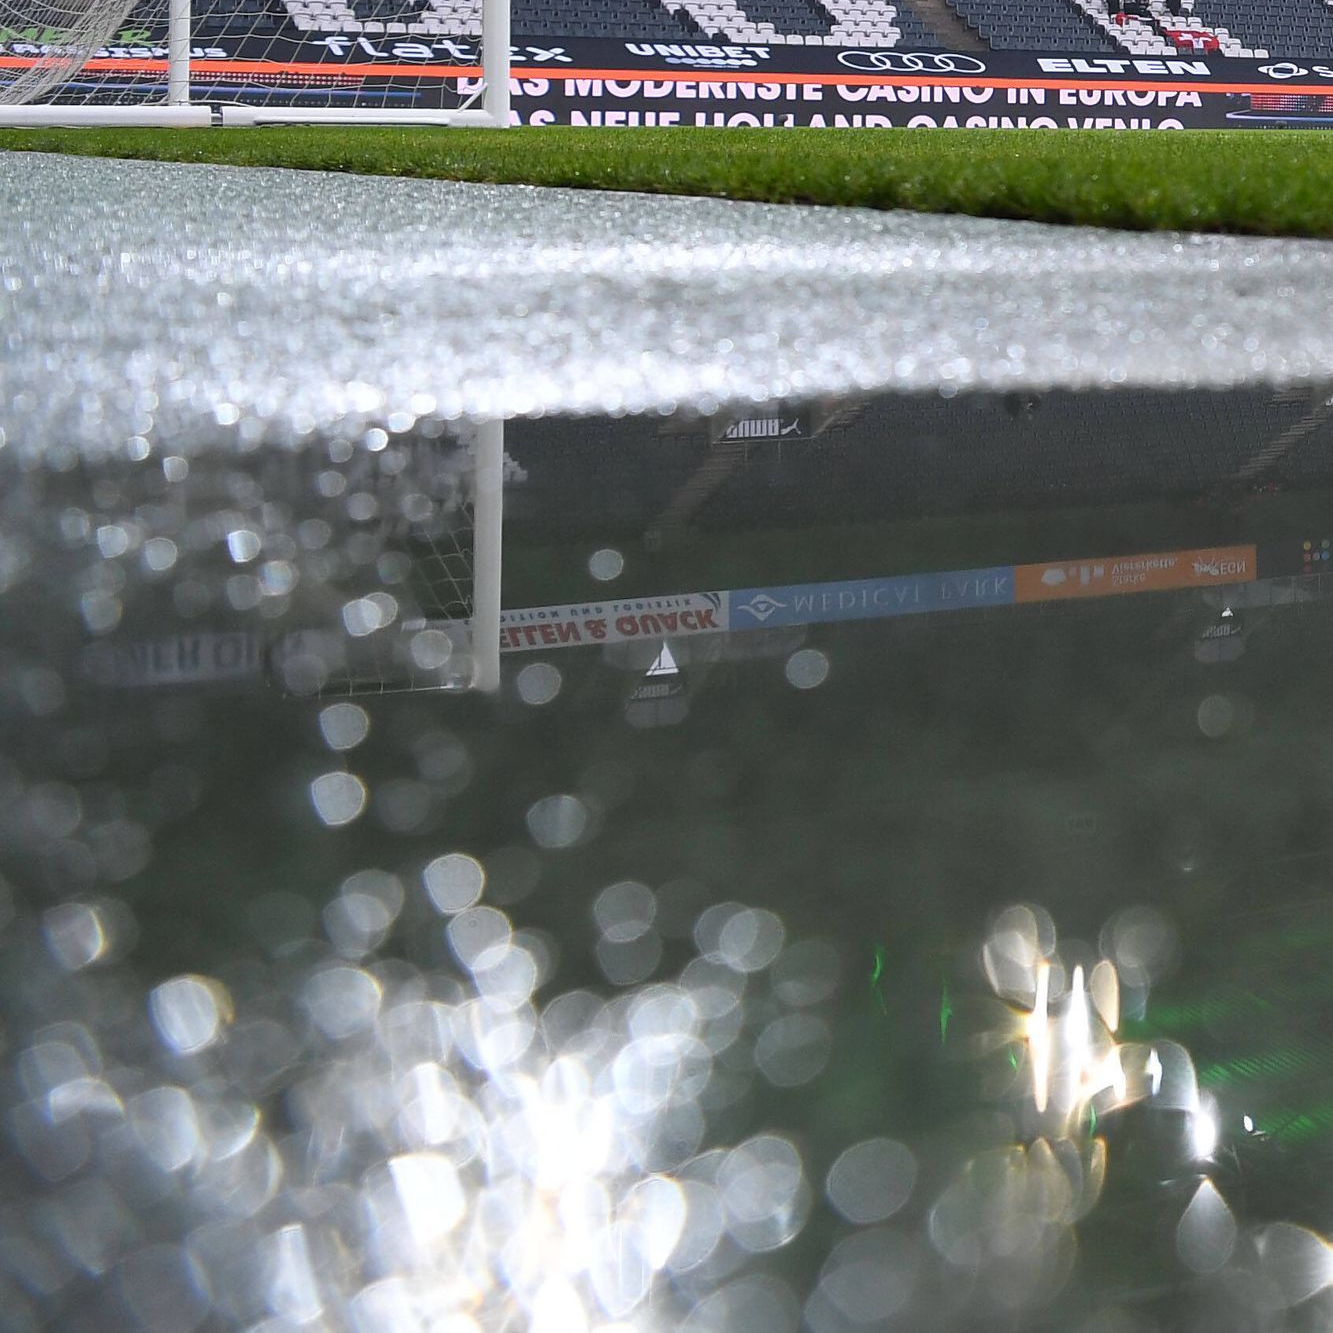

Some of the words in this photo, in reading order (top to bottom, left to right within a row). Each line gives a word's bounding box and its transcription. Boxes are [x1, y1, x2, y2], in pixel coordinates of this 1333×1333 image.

[625, 42, 770, 59] UNIBET
[1037, 58, 1211, 76] ELTEN
[564, 79, 823, 100] MODERNSTE
[836, 84, 993, 104] CASINO
[1007, 88, 1045, 104] IN
[1059, 89, 1203, 108] EUROPA
